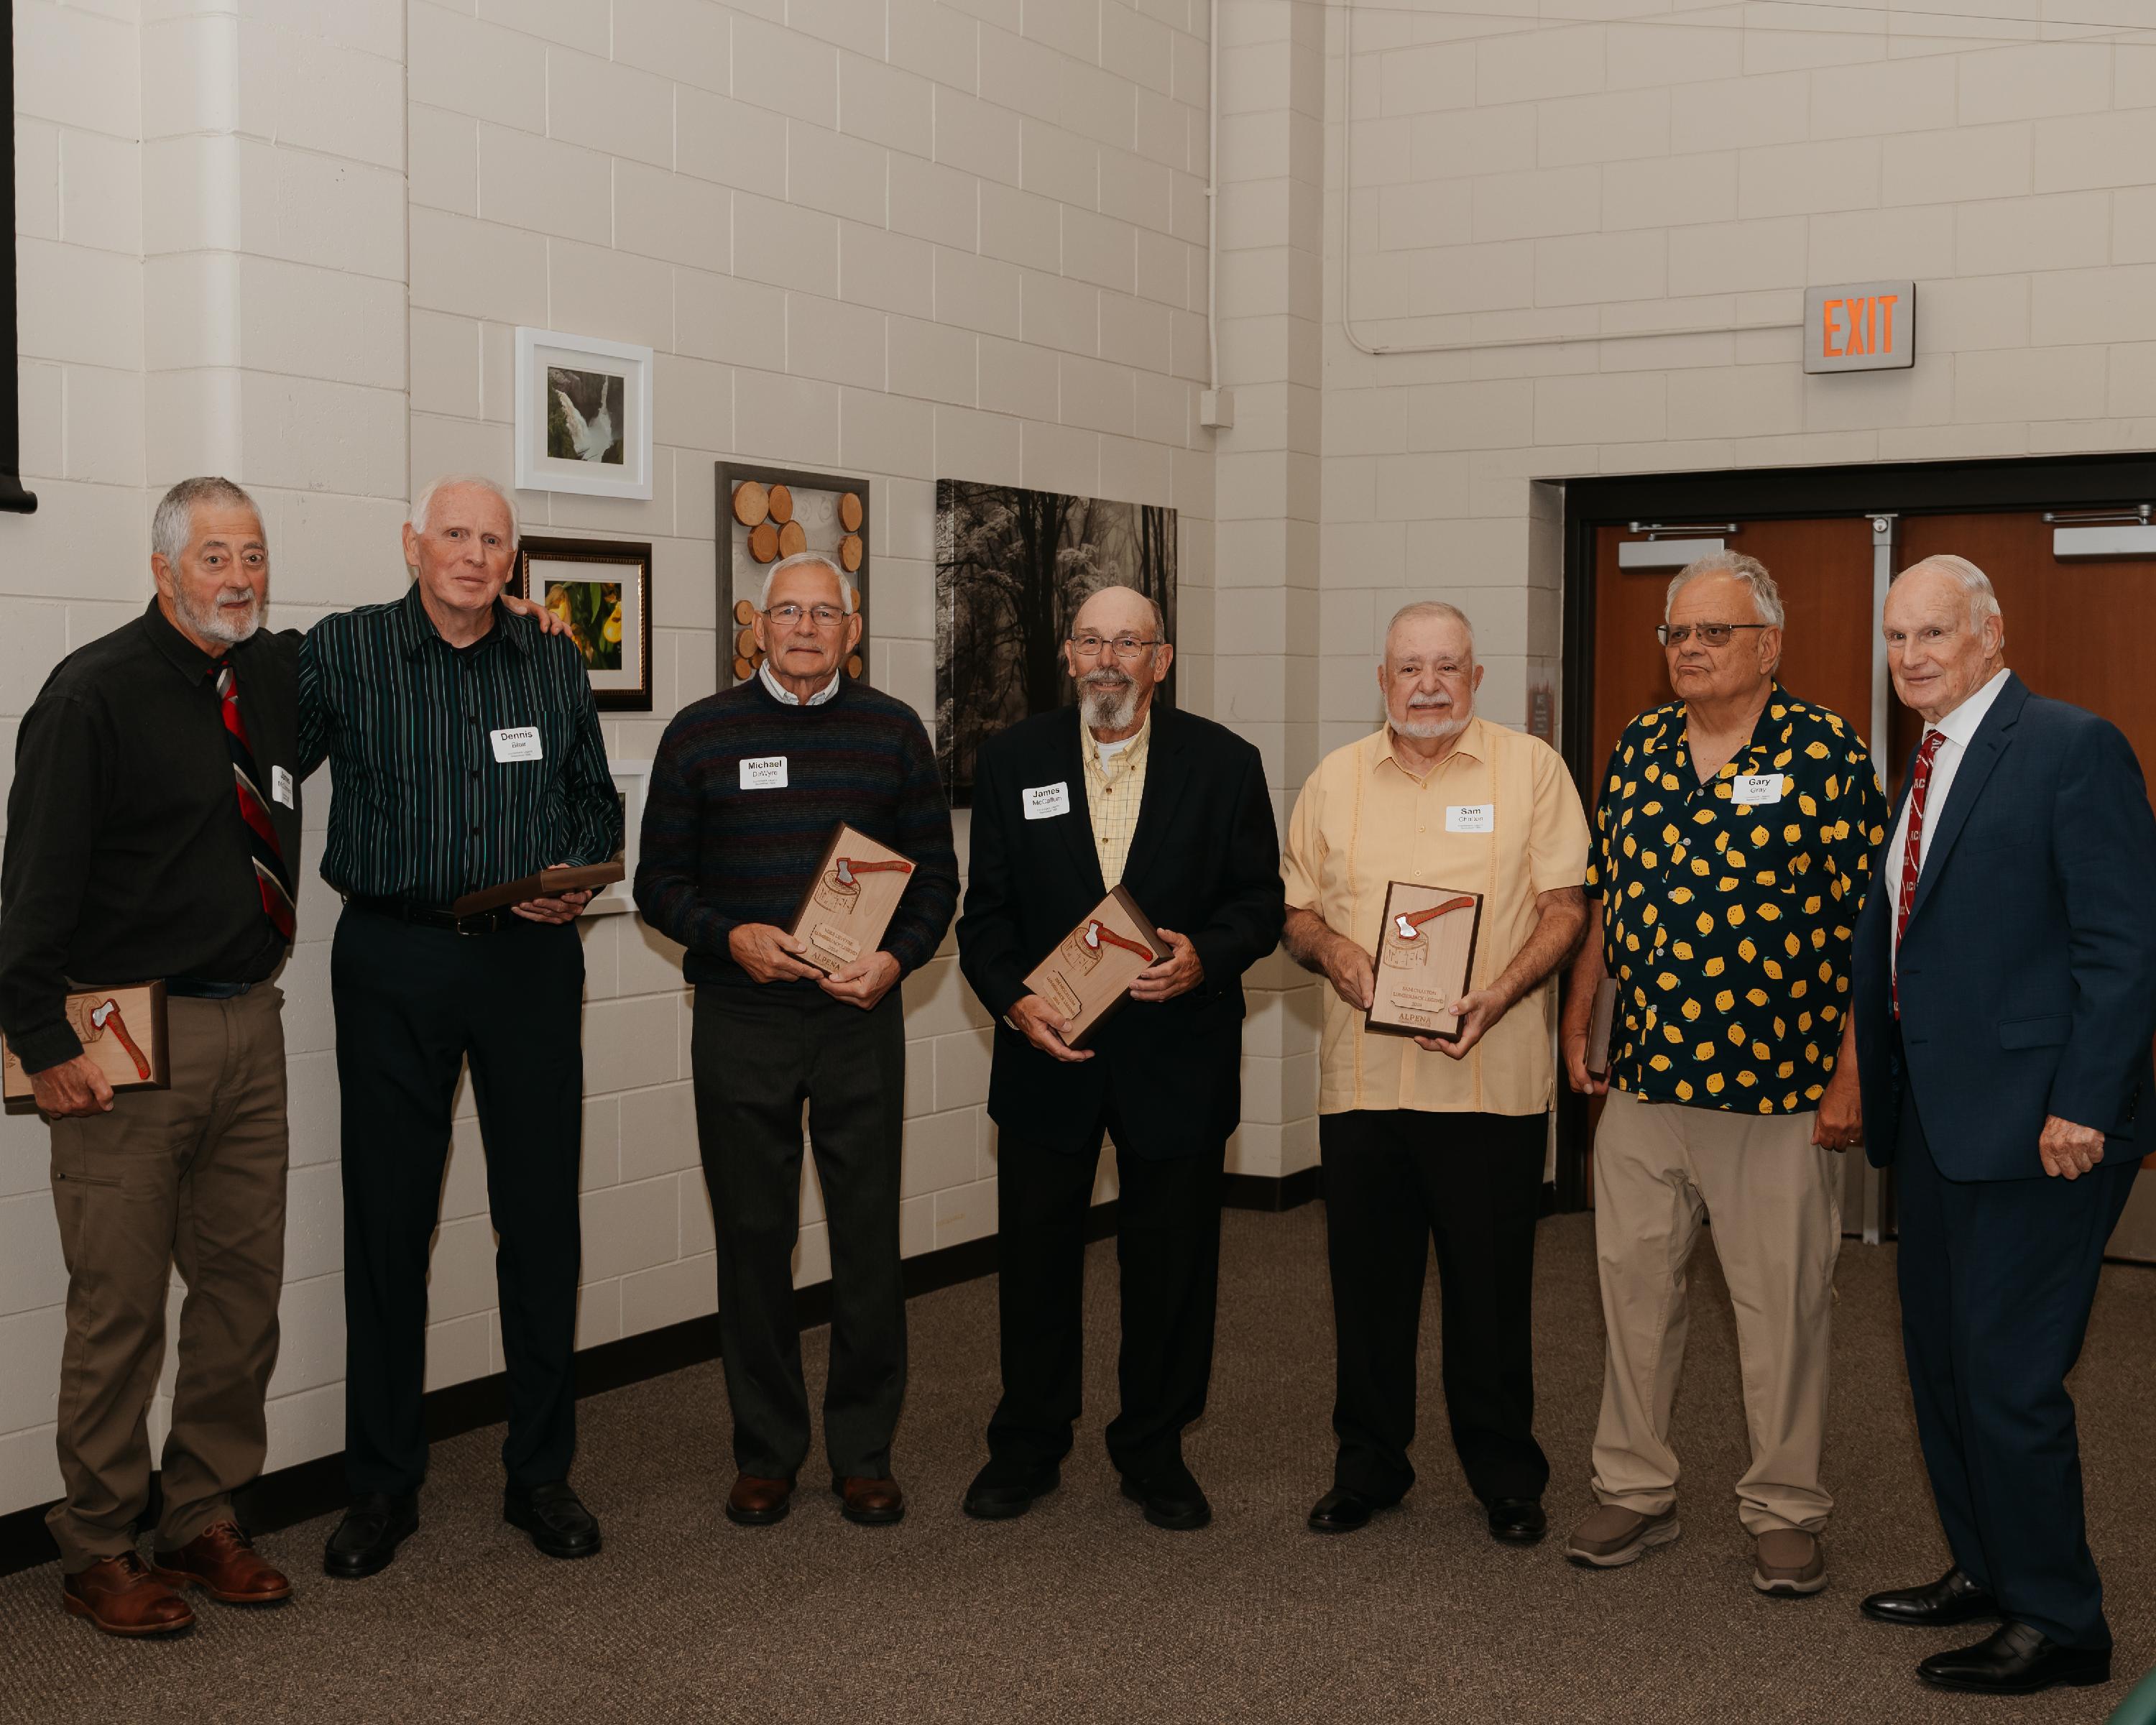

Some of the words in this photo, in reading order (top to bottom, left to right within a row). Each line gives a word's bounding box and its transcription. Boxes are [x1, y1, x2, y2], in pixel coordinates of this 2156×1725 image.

[1823, 295, 1898, 357] EXIT
[501, 730, 533, 740] Dennis
[748, 760, 782, 769] Michael
[1033, 788, 1060, 798] James
[1032, 796, 1062, 806] McCallum
[813, 952, 840, 970] ALPENA
[1399, 1013, 1432, 1024] ALPENA
